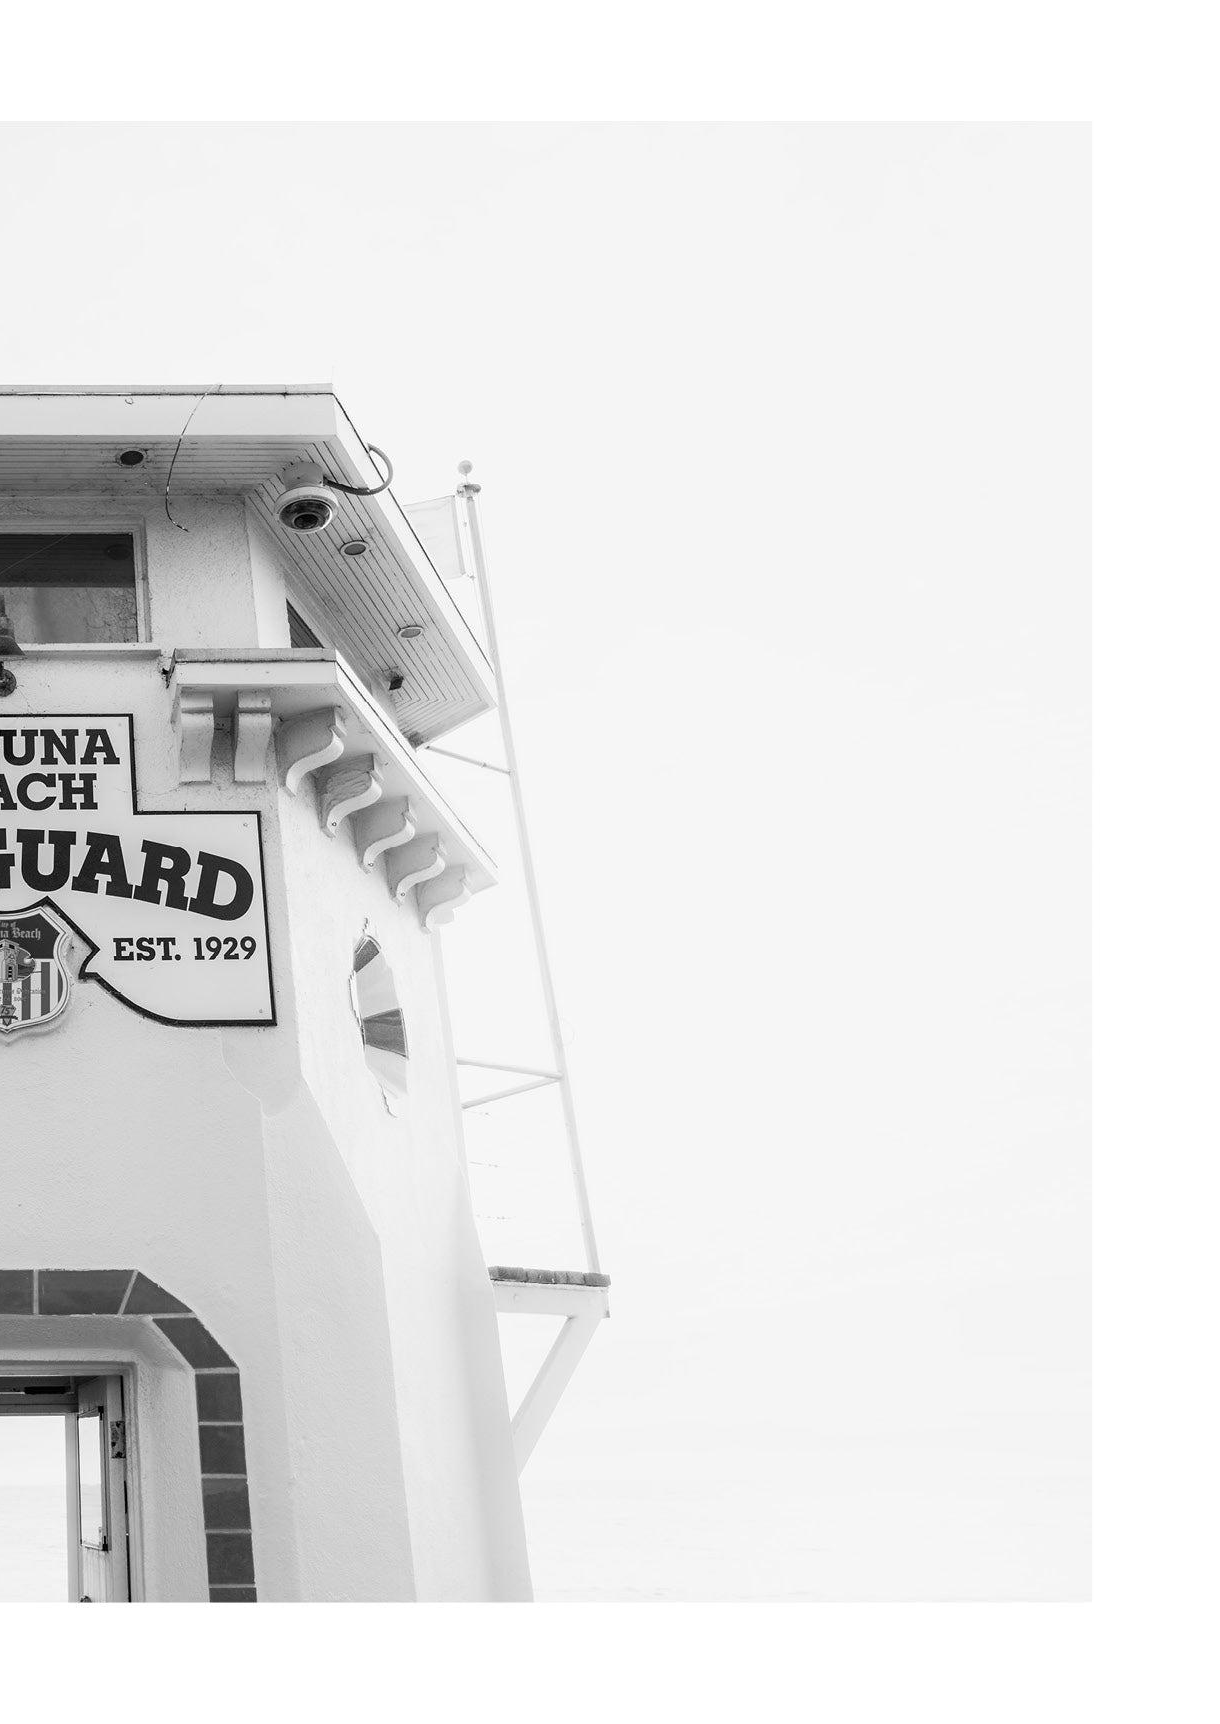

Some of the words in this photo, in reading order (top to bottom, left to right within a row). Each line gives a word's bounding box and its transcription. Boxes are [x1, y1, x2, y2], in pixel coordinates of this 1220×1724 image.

[12, 928, 41, 940] Beach
[112, 936, 182, 962] EST.
[193, 935, 257, 961] 1929
